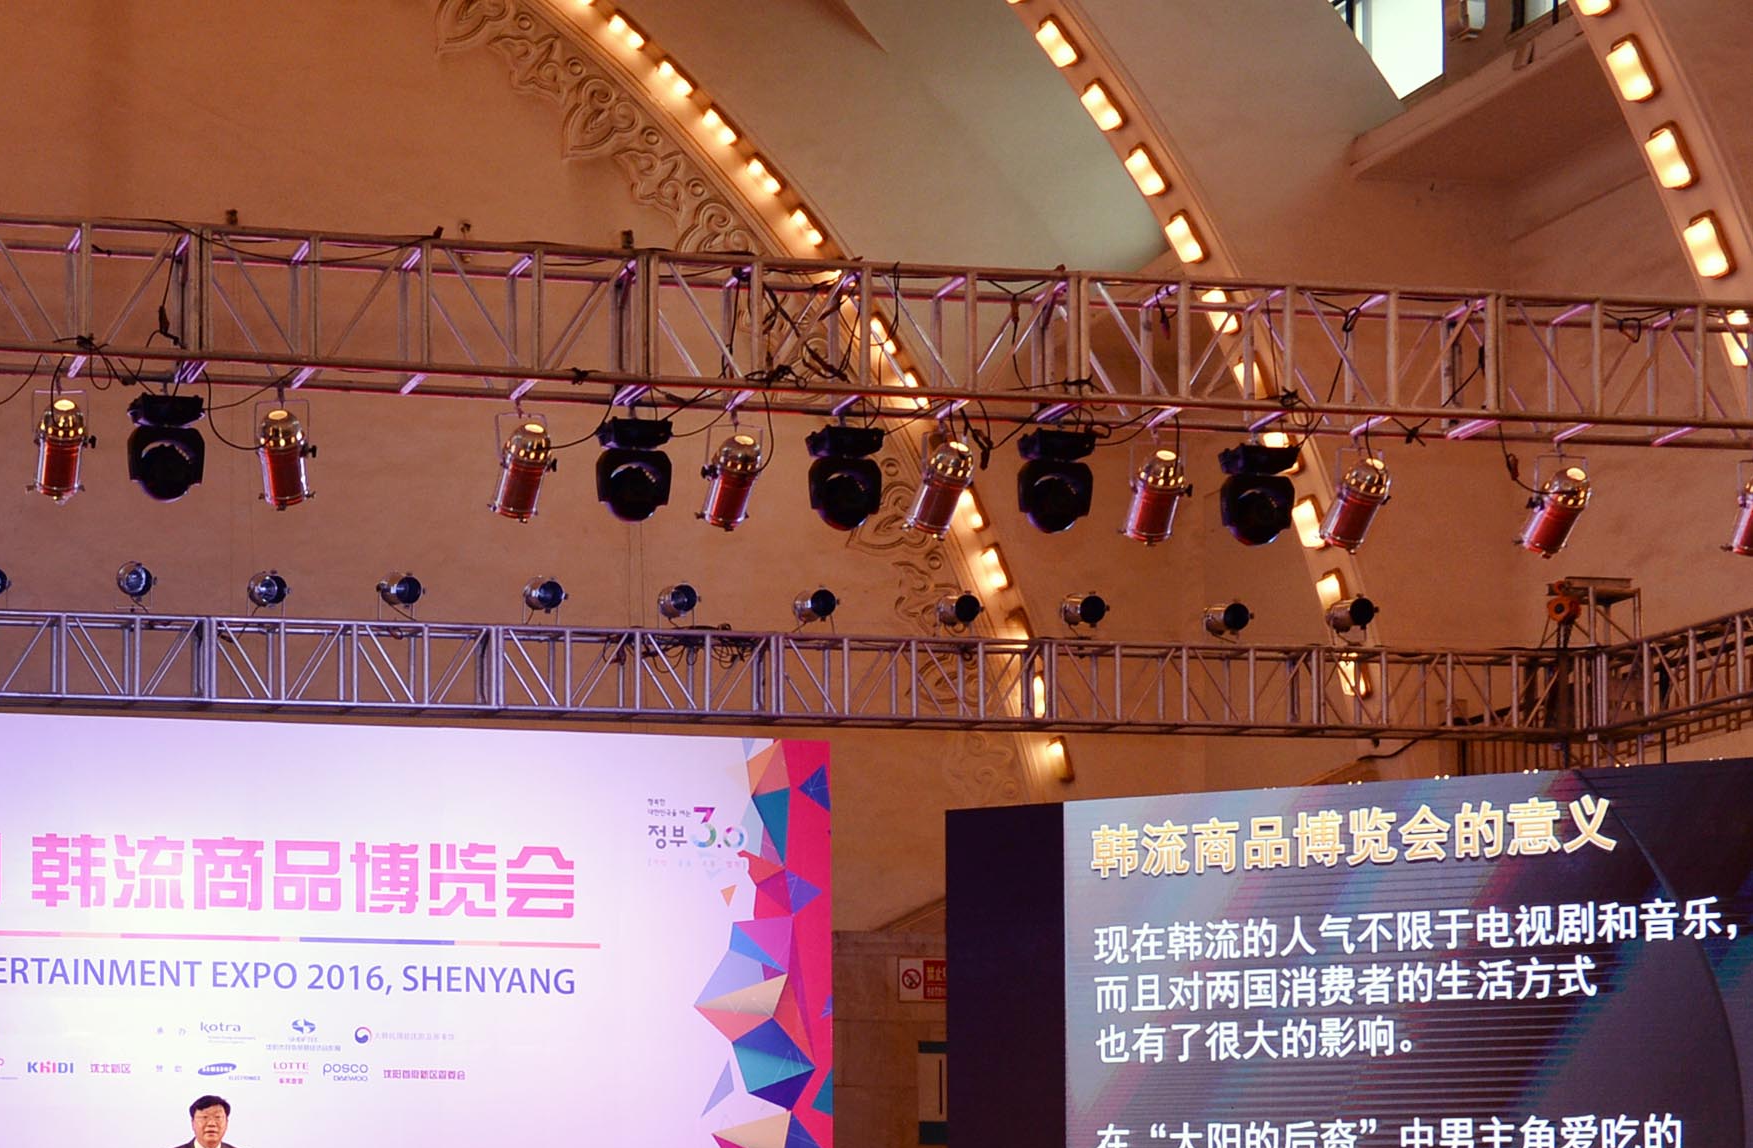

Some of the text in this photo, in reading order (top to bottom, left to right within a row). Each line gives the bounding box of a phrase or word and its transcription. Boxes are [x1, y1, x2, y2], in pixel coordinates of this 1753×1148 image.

[647, 825, 688, 849] 정부
[1089, 795, 1618, 880] 韩流商品博览会的意义
[31, 832, 575, 919] 韩流商品博览会
[213, 961, 297, 990] EXPO
[308, 963, 392, 996] 2016,
[402, 965, 575, 995] SHENYANG
[1094, 954, 1598, 1014] 而且对两国消费者的生活方式
[200, 1021, 241, 1033] kotra
[1095, 1016, 1414, 1065] 也有了很大的影响。
[273, 1061, 309, 1070] LOTTE
[323, 1063, 368, 1076] posco
